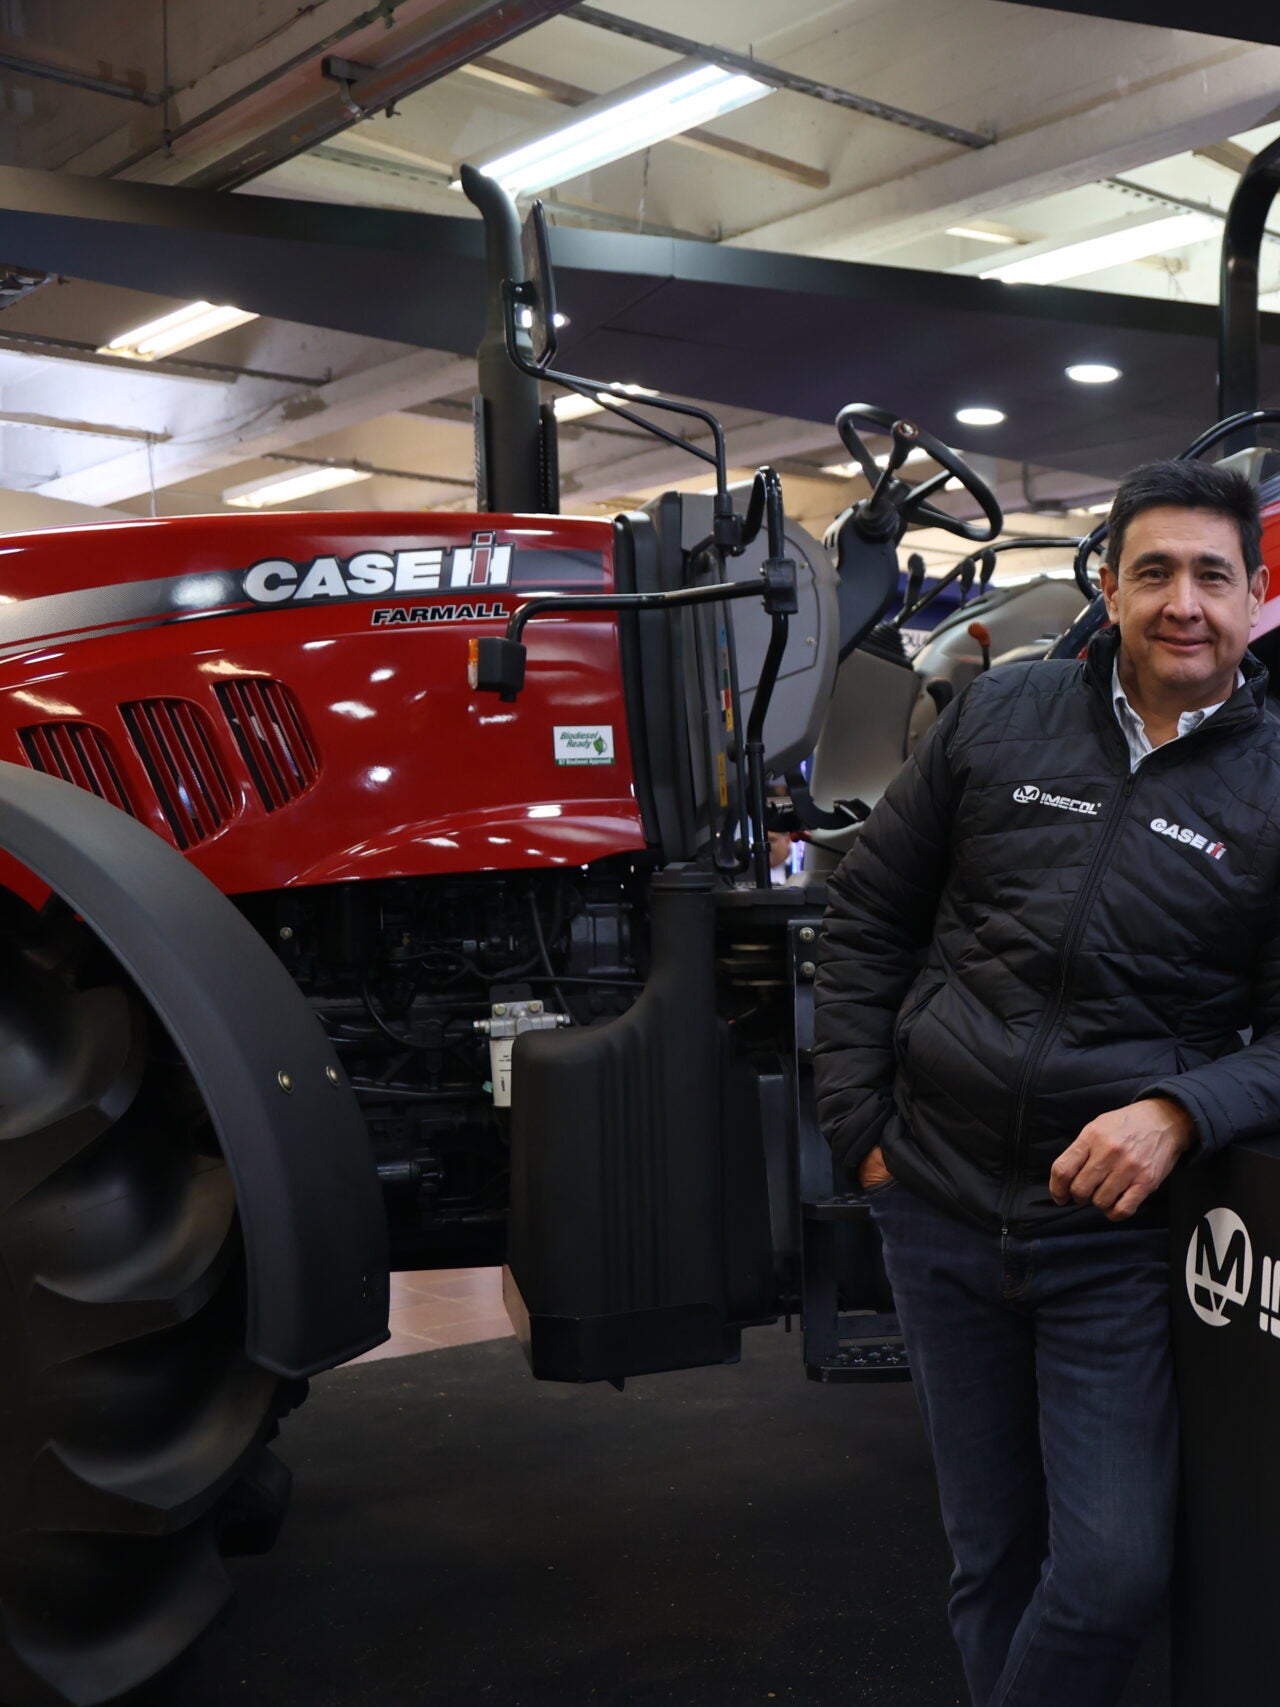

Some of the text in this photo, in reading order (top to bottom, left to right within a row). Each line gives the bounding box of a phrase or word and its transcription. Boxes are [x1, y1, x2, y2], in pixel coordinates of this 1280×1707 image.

[244, 549, 444, 603] CASE
[371, 603, 509, 626] FARMALL
[560, 731, 599, 740] Biodiesel
[566, 739, 592, 749] Ready
[1040, 793, 1098, 815] IMECOL
[1150, 817, 1206, 850] CASE
